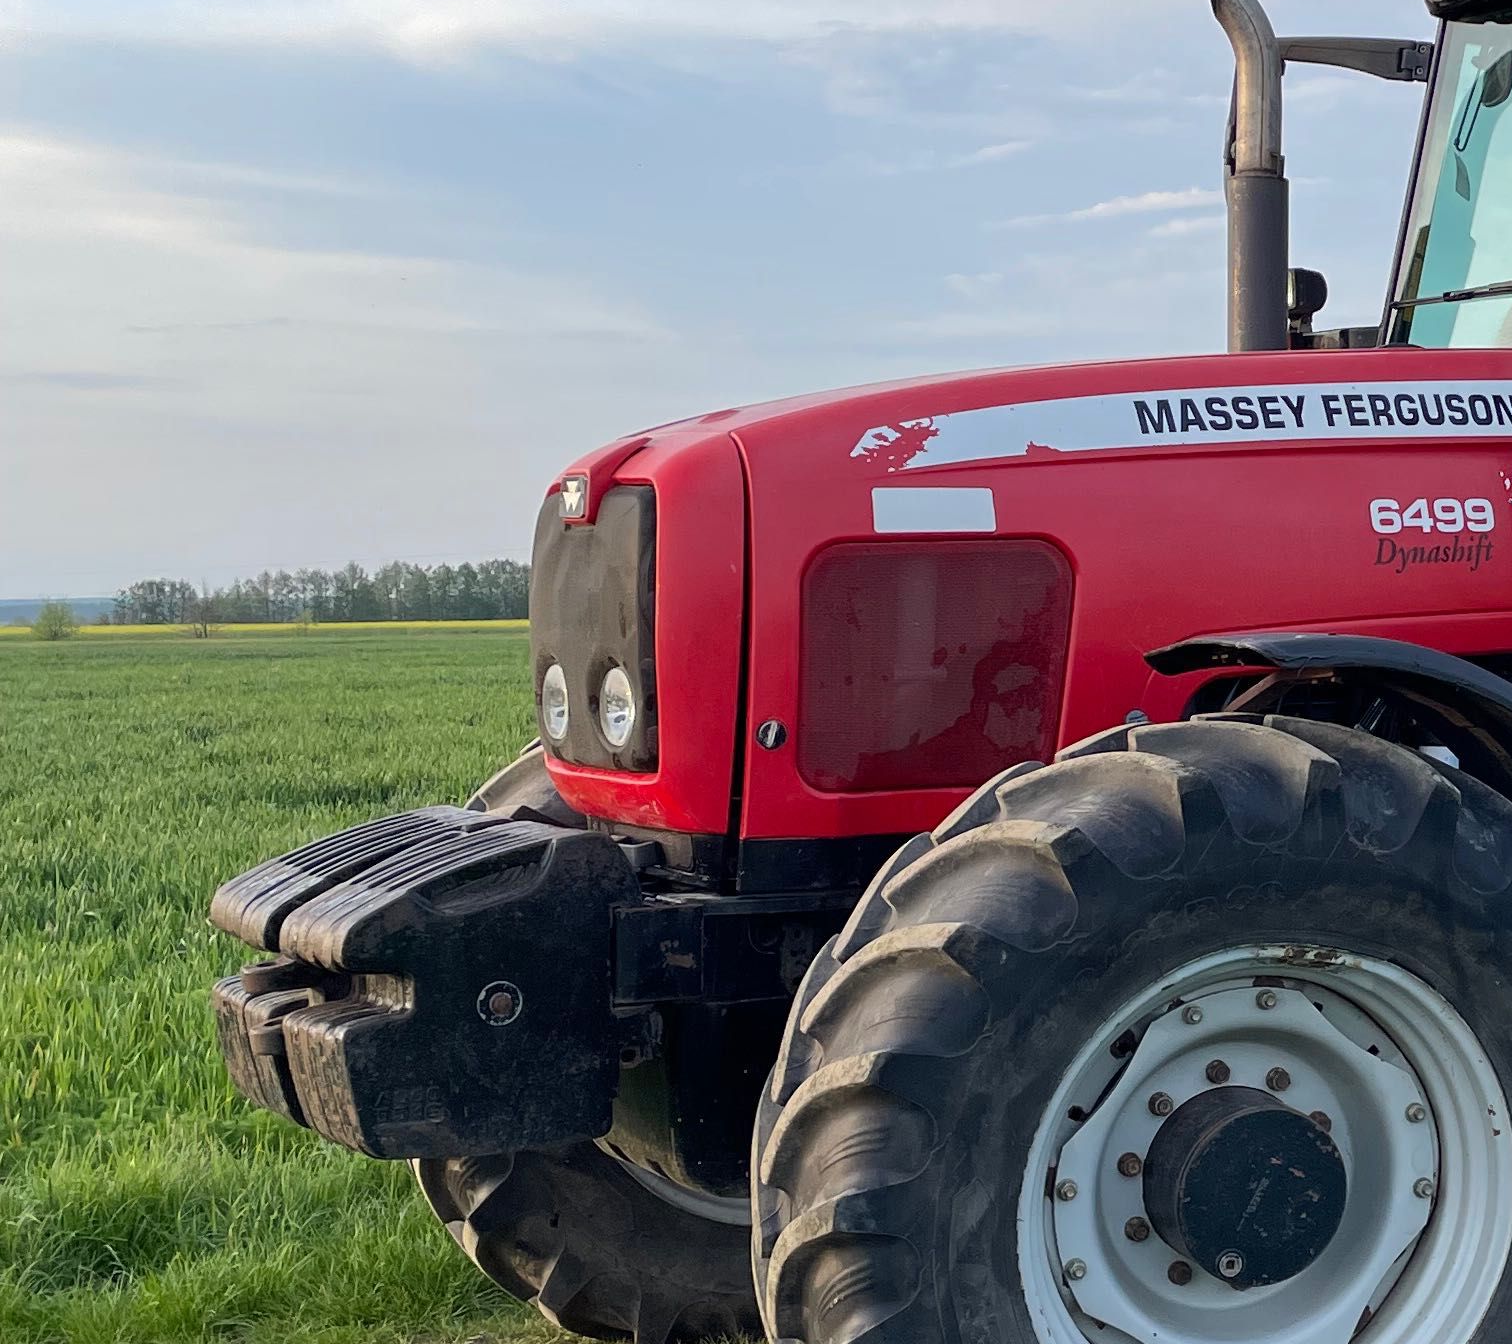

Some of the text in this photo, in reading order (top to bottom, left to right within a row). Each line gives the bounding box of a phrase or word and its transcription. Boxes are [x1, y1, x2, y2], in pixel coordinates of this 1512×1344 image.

[1133, 395, 1305, 434] MASSEY
[1369, 498, 1495, 534] 6499
[1374, 534, 1494, 574] Dynashift
